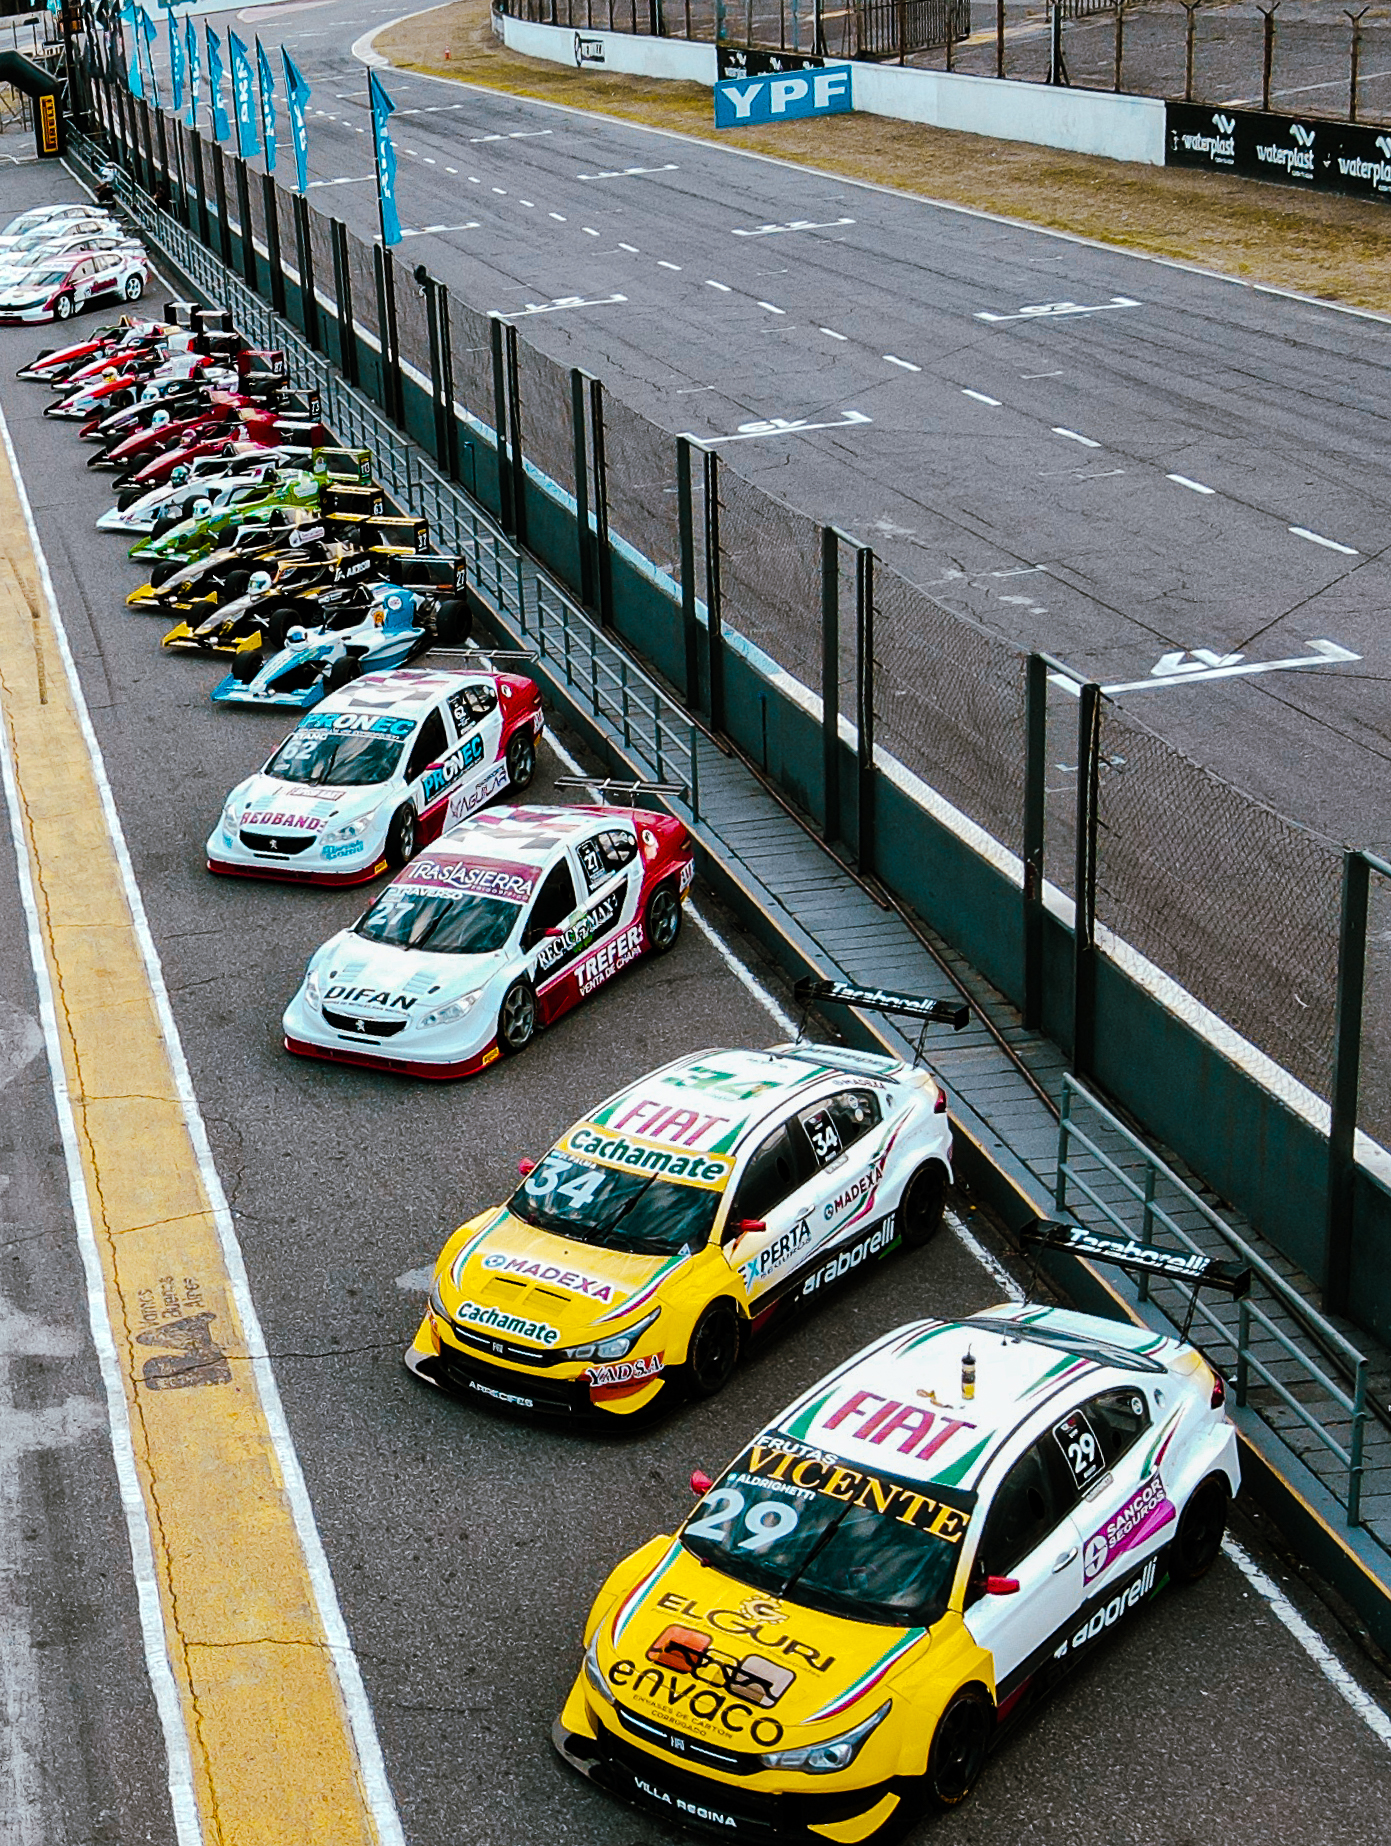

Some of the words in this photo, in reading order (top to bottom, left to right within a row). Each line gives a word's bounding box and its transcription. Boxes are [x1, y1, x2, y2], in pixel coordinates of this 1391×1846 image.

[721, 72, 848, 118] YPF
[41, 97, 57, 151] PIRELLI
[1182, 133, 1235, 161] waterplast
[1256, 143, 1315, 174] waterplast
[297, 712, 417, 736] PRONEC
[282, 740, 318, 760] 62
[422, 736, 483, 799] PRONEC
[408, 860, 533, 896] TRASLASIERRA
[583, 851, 599, 873] 27
[367, 901, 416, 926] 27
[399, 886, 465, 900] TRAVERSO
[323, 985, 419, 1011] DIFAN
[579, 971, 605, 996] VENTA
[605, 964, 616, 979] DE
[829, 980, 938, 1012] Taraborelli
[613, 1099, 730, 1147] FIAT
[812, 1126, 839, 1150] 34
[569, 1128, 726, 1181] Cachamate
[524, 1156, 607, 1210] 34
[833, 1165, 884, 1213] MADEXA
[736, 1217, 812, 1293] EXPERTA
[1069, 1227, 1211, 1275] Taraborelli
[504, 1257, 613, 1303] MADEXA
[457, 1301, 559, 1346] Cachamate
[586, 1364, 633, 1387] YAD
[634, 1355, 665, 1377] S.A.
[821, 1390, 978, 1461] FIAT
[756, 1435, 840, 1465] FRUTAS
[1067, 1432, 1096, 1474] 29
[736, 1472, 817, 1501] ALDRIGHETTI
[750, 1445, 971, 1544] VICENTE
[1106, 1478, 1163, 1538] SANCOR
[684, 1487, 799, 1550] 29
[1108, 1489, 1165, 1549] SEGUROS
[656, 1592, 703, 1622] EL
[704, 1607, 836, 1673] GURI
[608, 1658, 783, 1747] envaco
[632, 1693, 676, 1717] ENVASES
[677, 1711, 690, 1723] DE
[691, 1717, 734, 1740] CARTON
[651, 1709, 707, 1737] CORRUGADO
[634, 1776, 672, 1804] VILLA
[677, 1798, 737, 1828] REGINA
